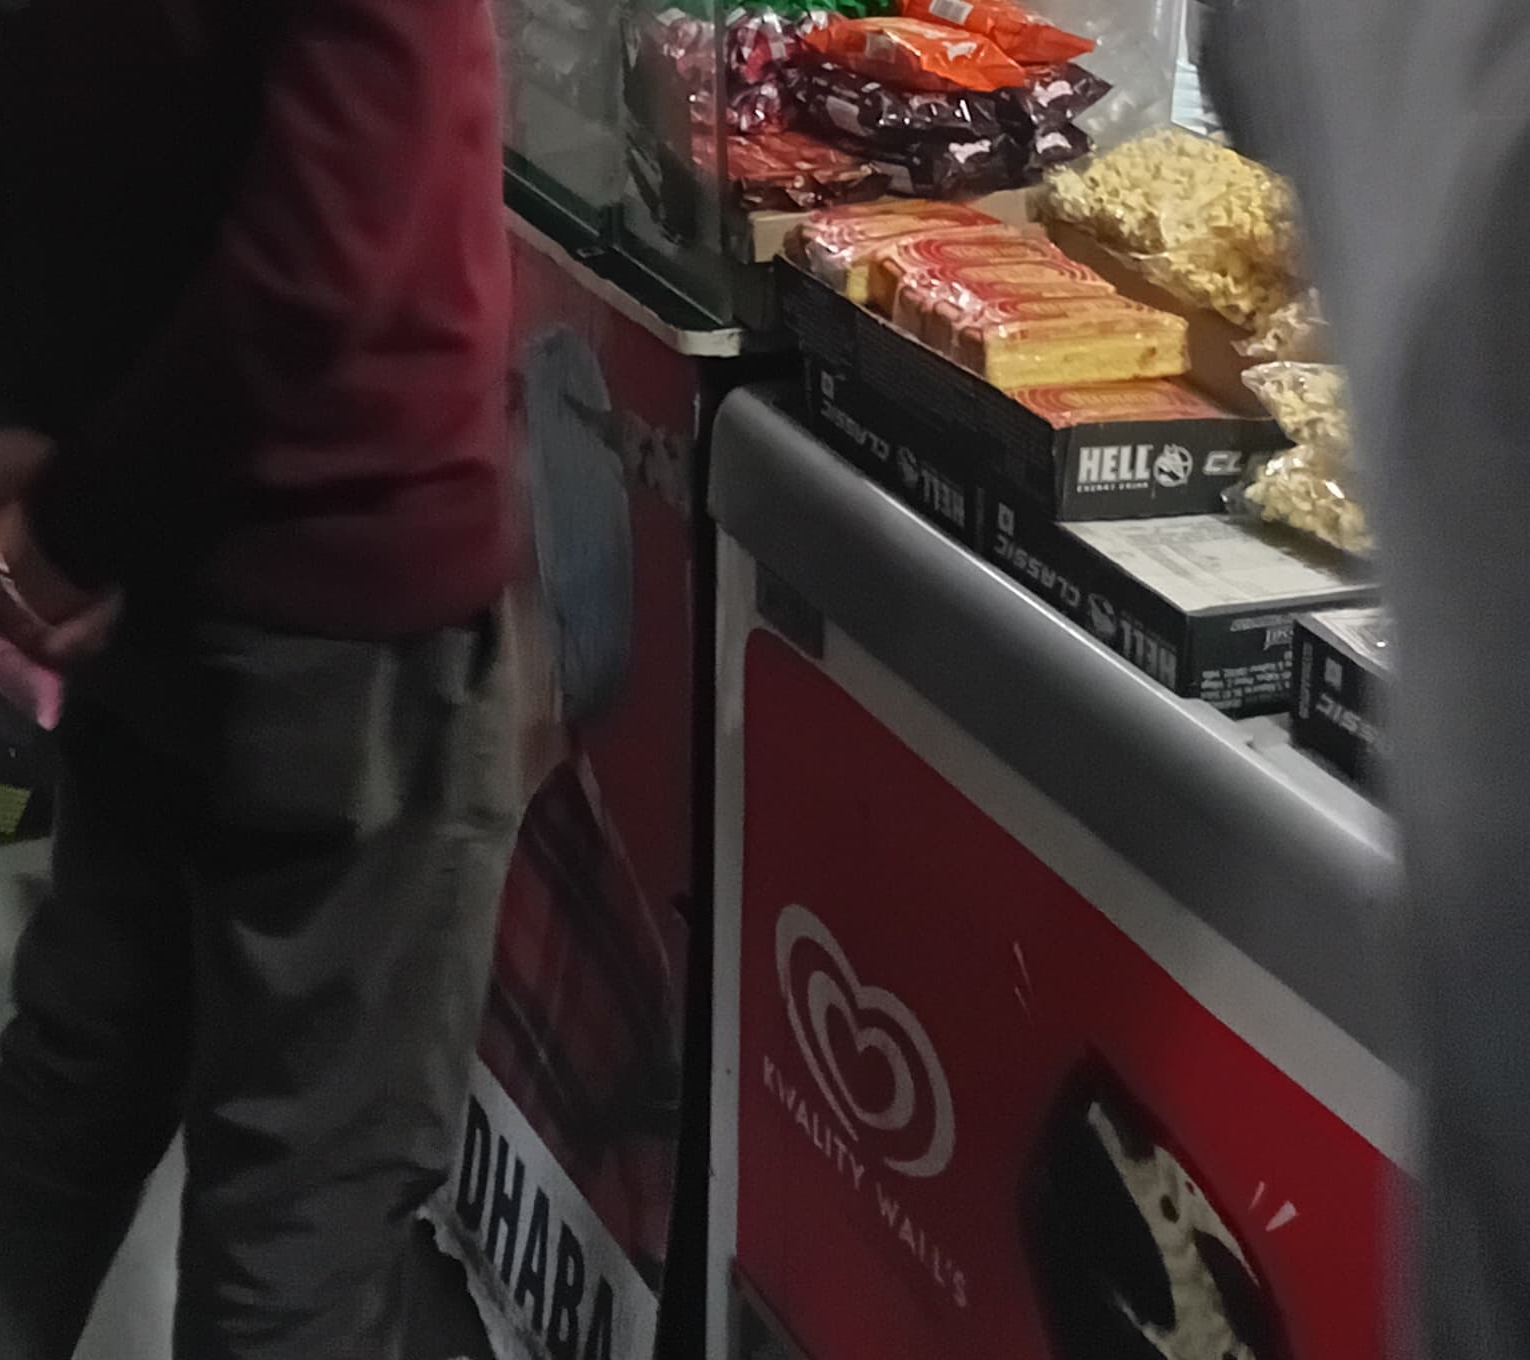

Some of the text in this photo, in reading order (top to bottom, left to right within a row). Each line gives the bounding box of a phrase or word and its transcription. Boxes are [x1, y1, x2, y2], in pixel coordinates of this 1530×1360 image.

[1079, 444, 1154, 483] HELL
[992, 533, 1081, 610] CLASSIC
[1121, 618, 1177, 689] HELL
[763, 1055, 968, 1309] KWALITY WALL'S
[456, 1093, 615, 1360] DHABA
